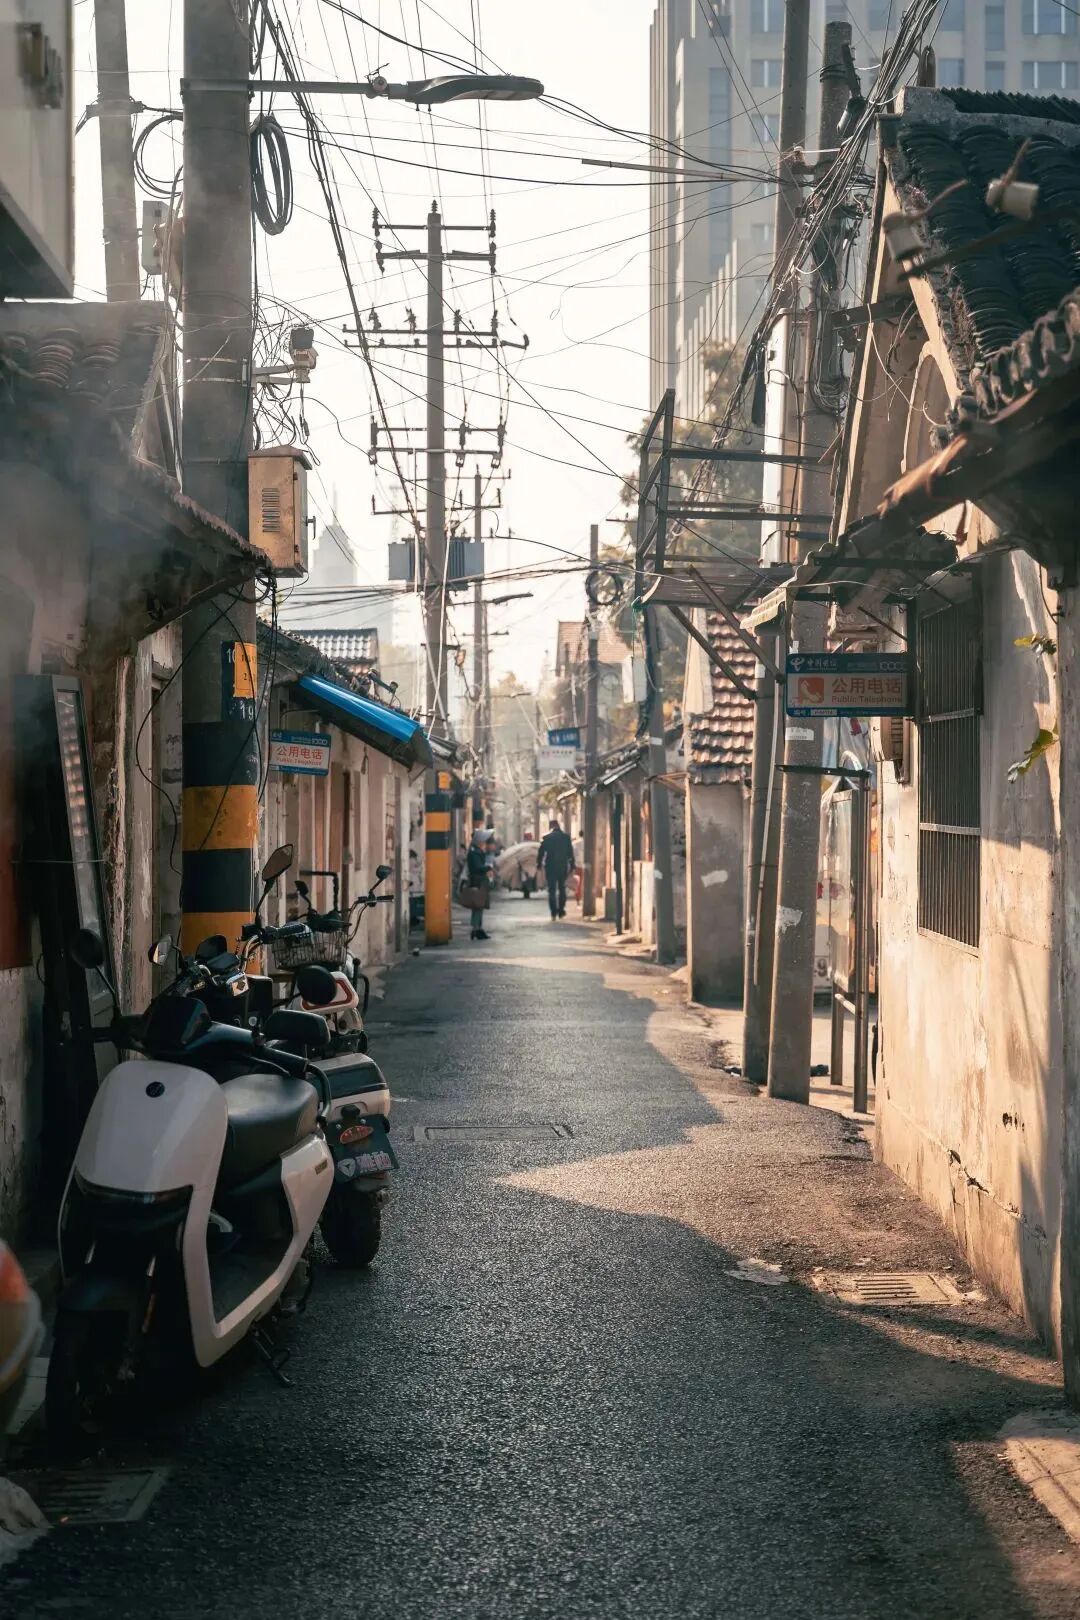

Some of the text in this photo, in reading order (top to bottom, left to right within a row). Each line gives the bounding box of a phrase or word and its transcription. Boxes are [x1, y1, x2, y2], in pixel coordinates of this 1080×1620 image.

[832, 677, 903, 694] 公用电话
[832, 695, 903, 705] Public Telephone
[276, 745, 324, 760] 公用电话
